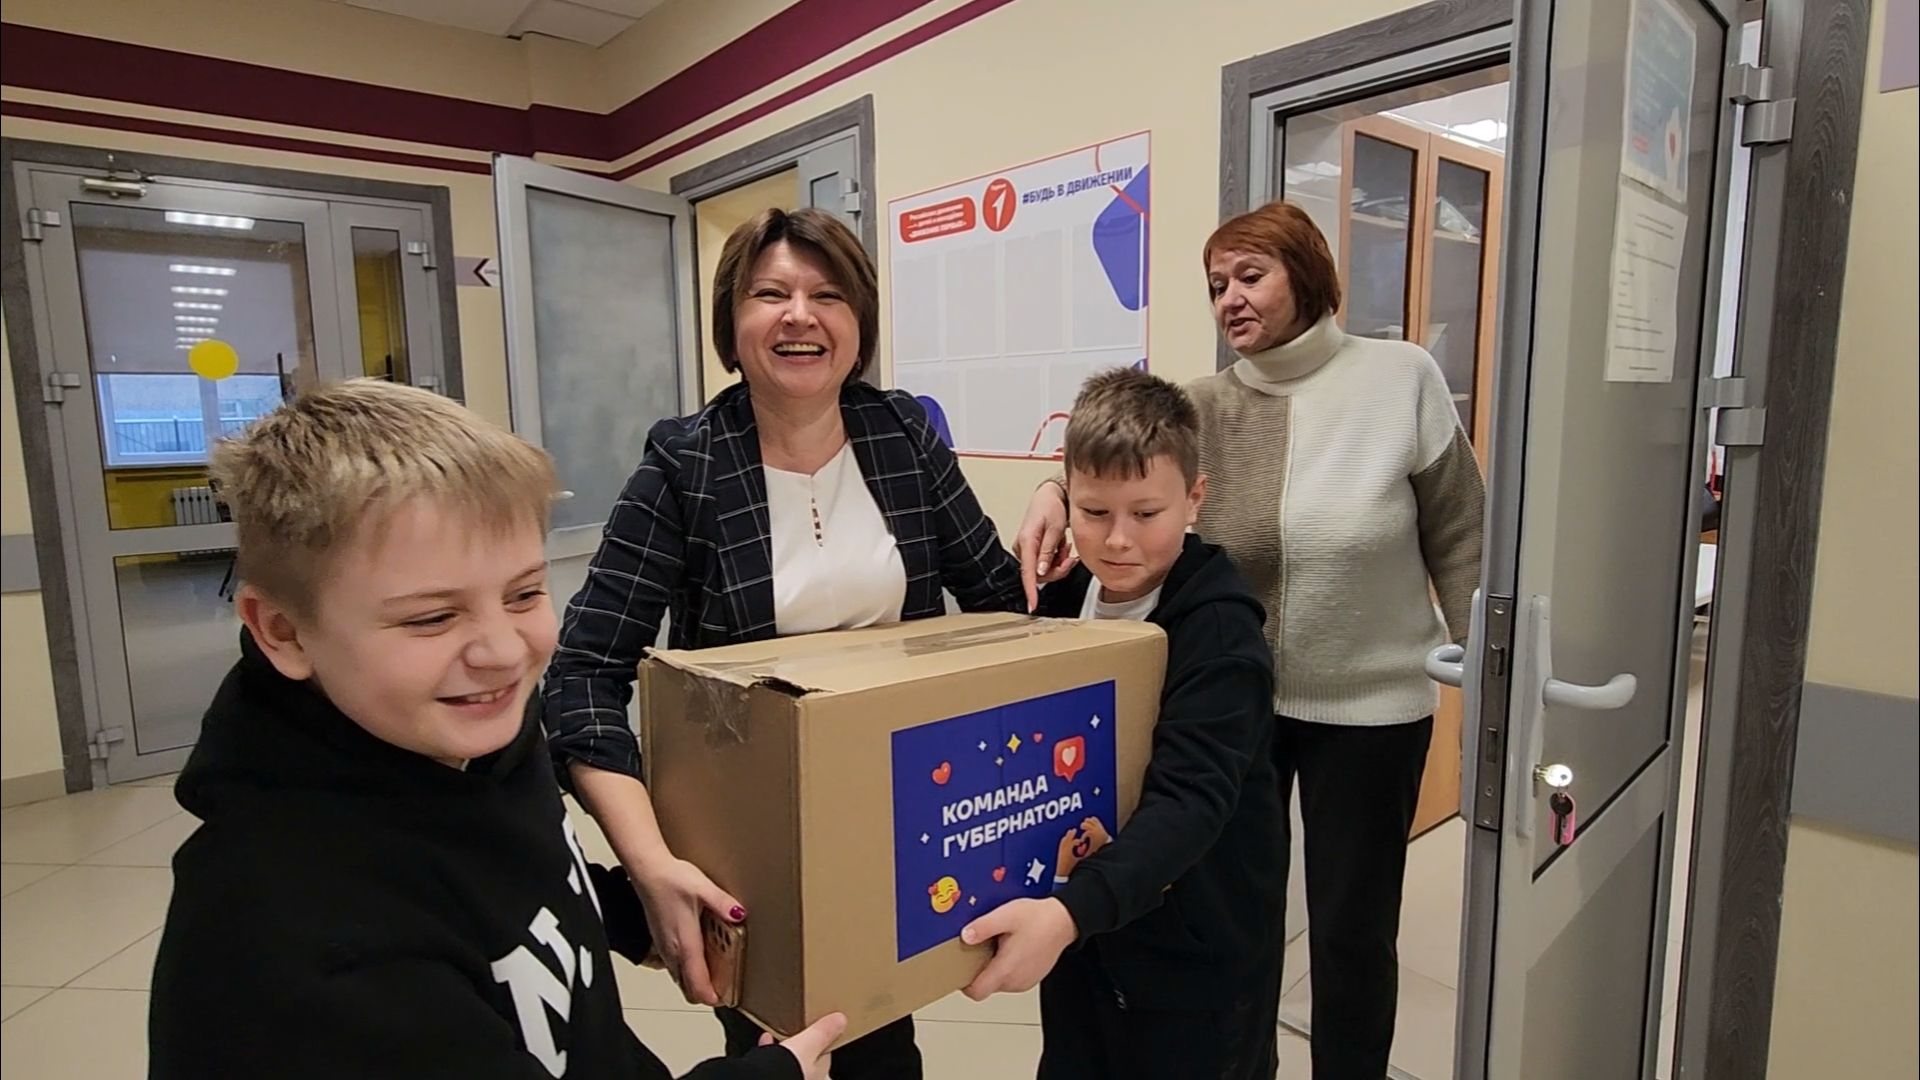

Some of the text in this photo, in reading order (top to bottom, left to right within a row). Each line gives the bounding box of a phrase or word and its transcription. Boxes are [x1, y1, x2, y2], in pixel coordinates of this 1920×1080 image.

[1022, 186, 1055, 204] #БУДЬ
[1057, 184, 1065, 197] В
[1066, 166, 1132, 197] ДВИЖЕНИИ
[942, 775, 1048, 826] КОМАНДА
[943, 792, 1082, 858] ГУБЕРНАТОРА
